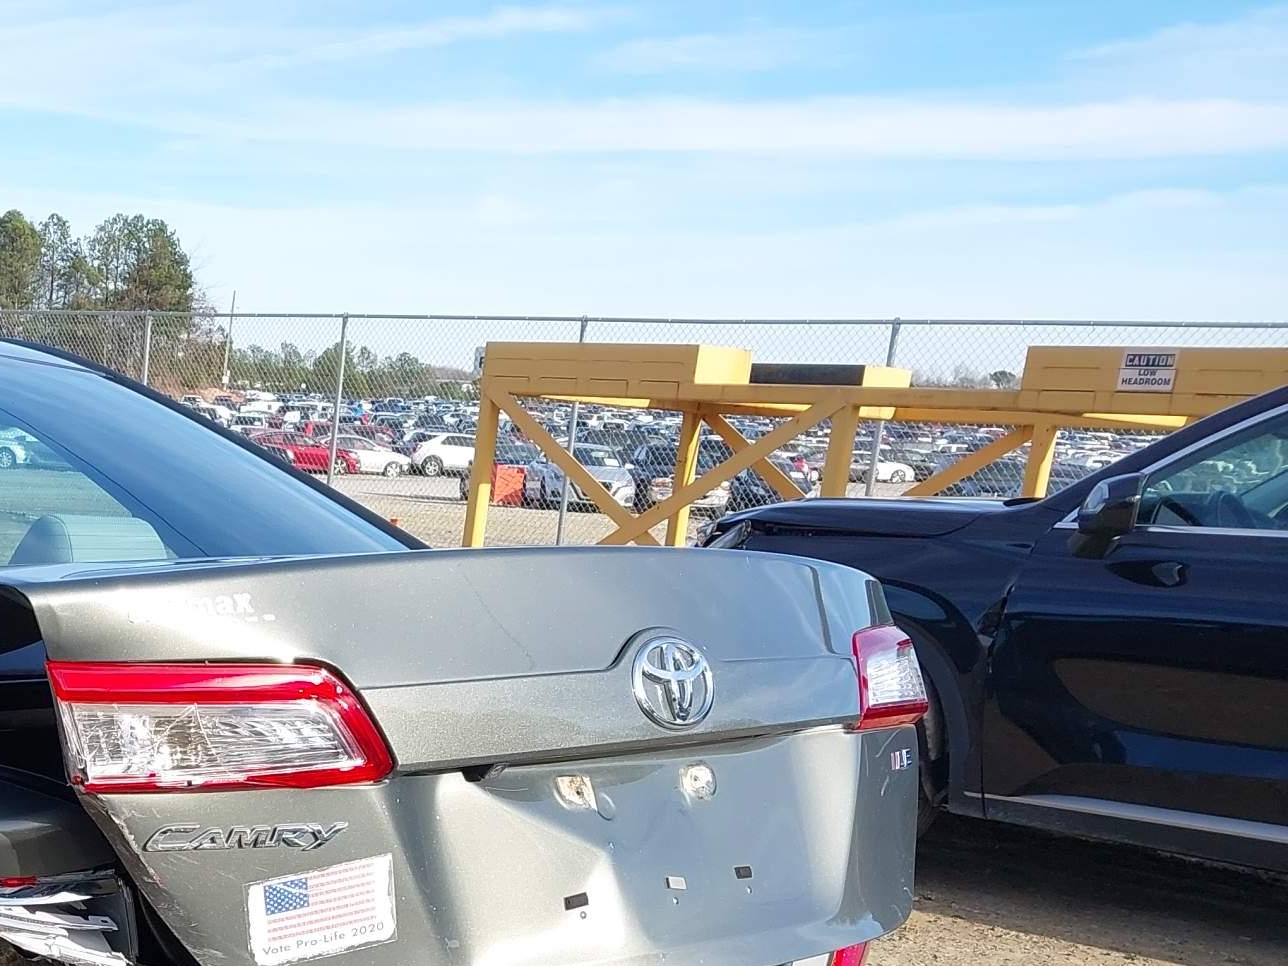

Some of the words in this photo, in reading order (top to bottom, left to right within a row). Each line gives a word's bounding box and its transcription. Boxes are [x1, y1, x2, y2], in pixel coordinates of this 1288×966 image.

[1126, 355, 1176, 366] CAUTION
[142, 822, 349, 851] CAMRY
[261, 943, 292, 956] Vote
[295, 932, 347, 950] Pro-Life
[351, 921, 386, 939] 2020
